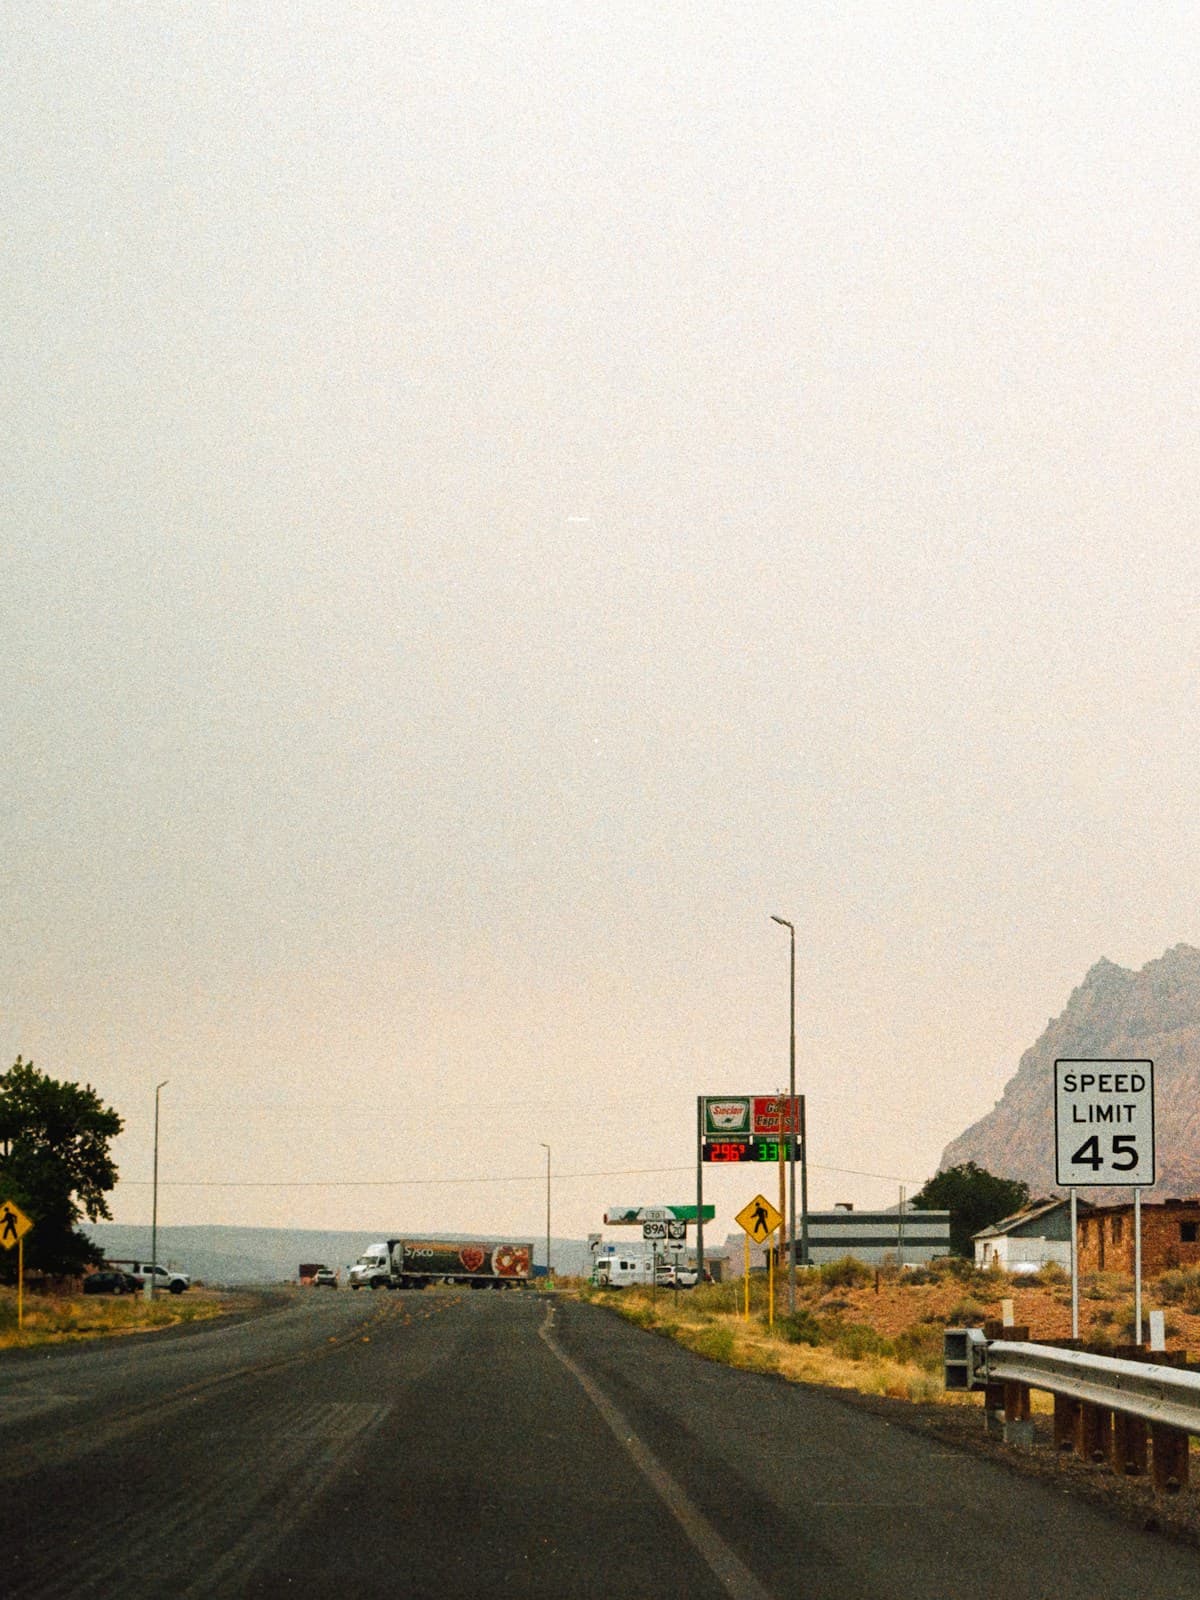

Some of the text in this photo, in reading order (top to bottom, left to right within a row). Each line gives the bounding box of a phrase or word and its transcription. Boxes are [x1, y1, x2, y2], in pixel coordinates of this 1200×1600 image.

[1063, 1074, 1146, 1093] SPEED
[712, 1105, 744, 1115] Sinclair
[1072, 1104, 1137, 1123] LIMIT
[1070, 1135, 1139, 1171] 45
[643, 1224, 665, 1235] 89A
